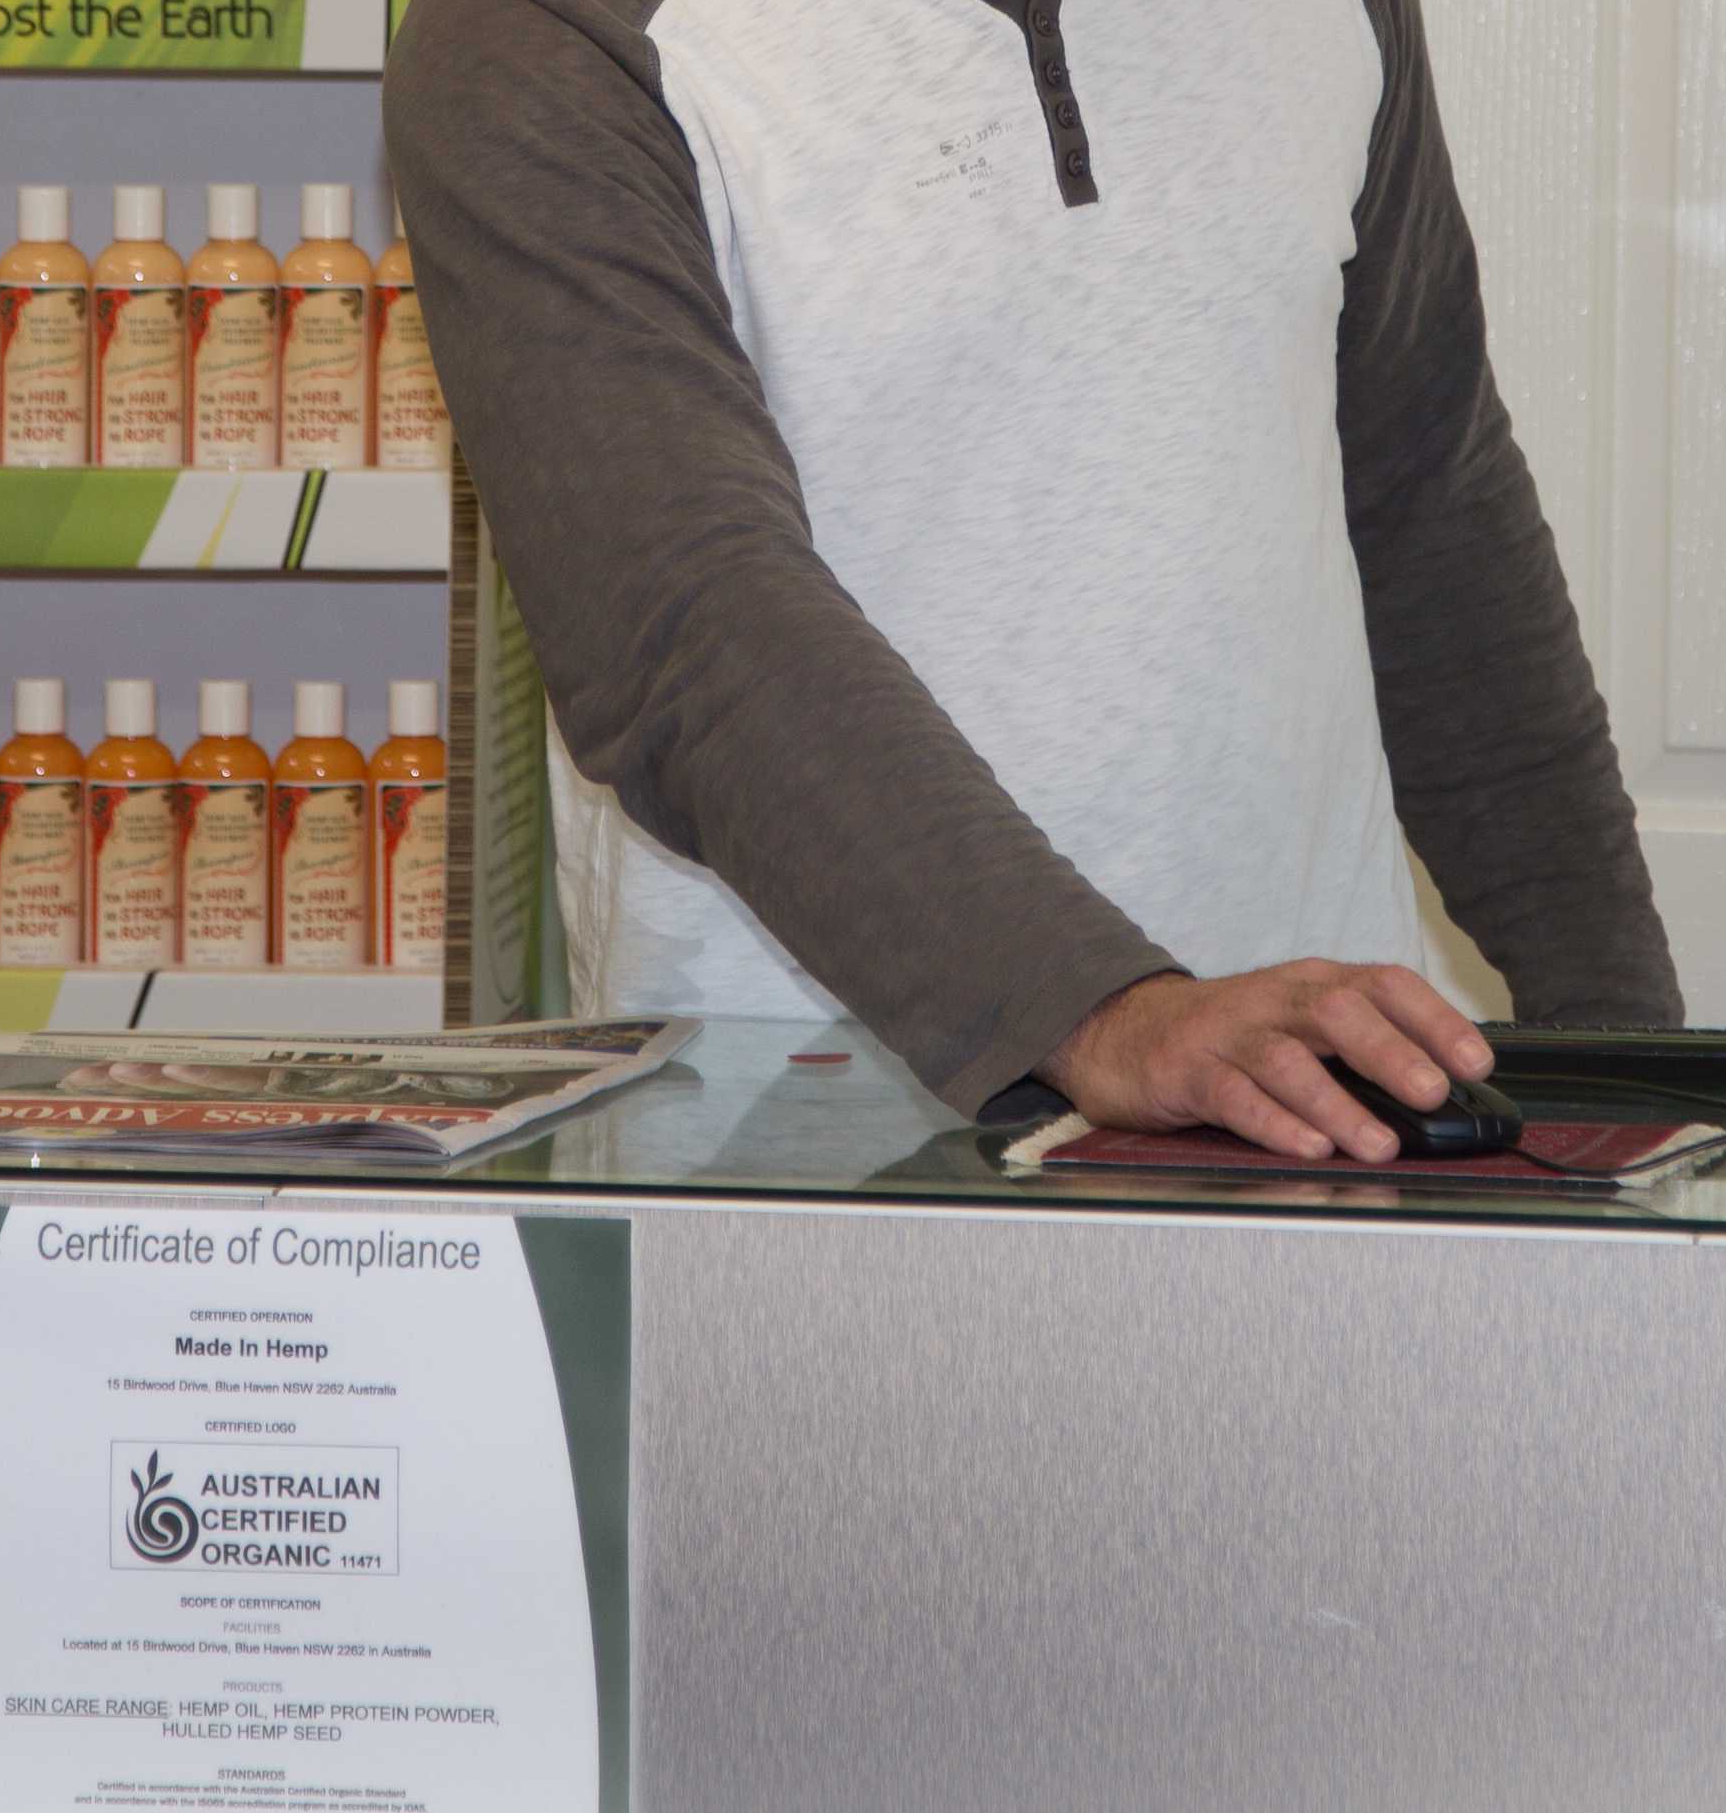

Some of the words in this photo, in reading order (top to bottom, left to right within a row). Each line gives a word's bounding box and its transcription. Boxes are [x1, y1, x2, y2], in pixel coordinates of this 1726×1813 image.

[37, 1222, 214, 1265] Certificate
[226, 1227, 261, 1265] of
[272, 1228, 481, 1276] Compliance
[174, 1337, 232, 1358] Made
[239, 1338, 259, 1359] In
[266, 1339, 329, 1363] Hemp
[283, 1382, 312, 1395] NSW
[348, 1383, 397, 1396] Australia
[201, 1475, 381, 1501] AUSTRALIAN
[201, 1510, 348, 1534] CERTIFIED
[201, 1543, 331, 1568] ORGANIC
[340, 1555, 382, 1569] 11471
[4, 1697, 47, 1717] SKIN
[51, 1698, 100, 1718] CARE
[178, 1701, 230, 1718] HEMP
[273, 1703, 324, 1721] HEMP
[329, 1704, 409, 1722] PROTEIN
[162, 1722, 232, 1740] HULLED
[237, 1723, 289, 1742] HEMP
[293, 1725, 342, 1742] SEED
